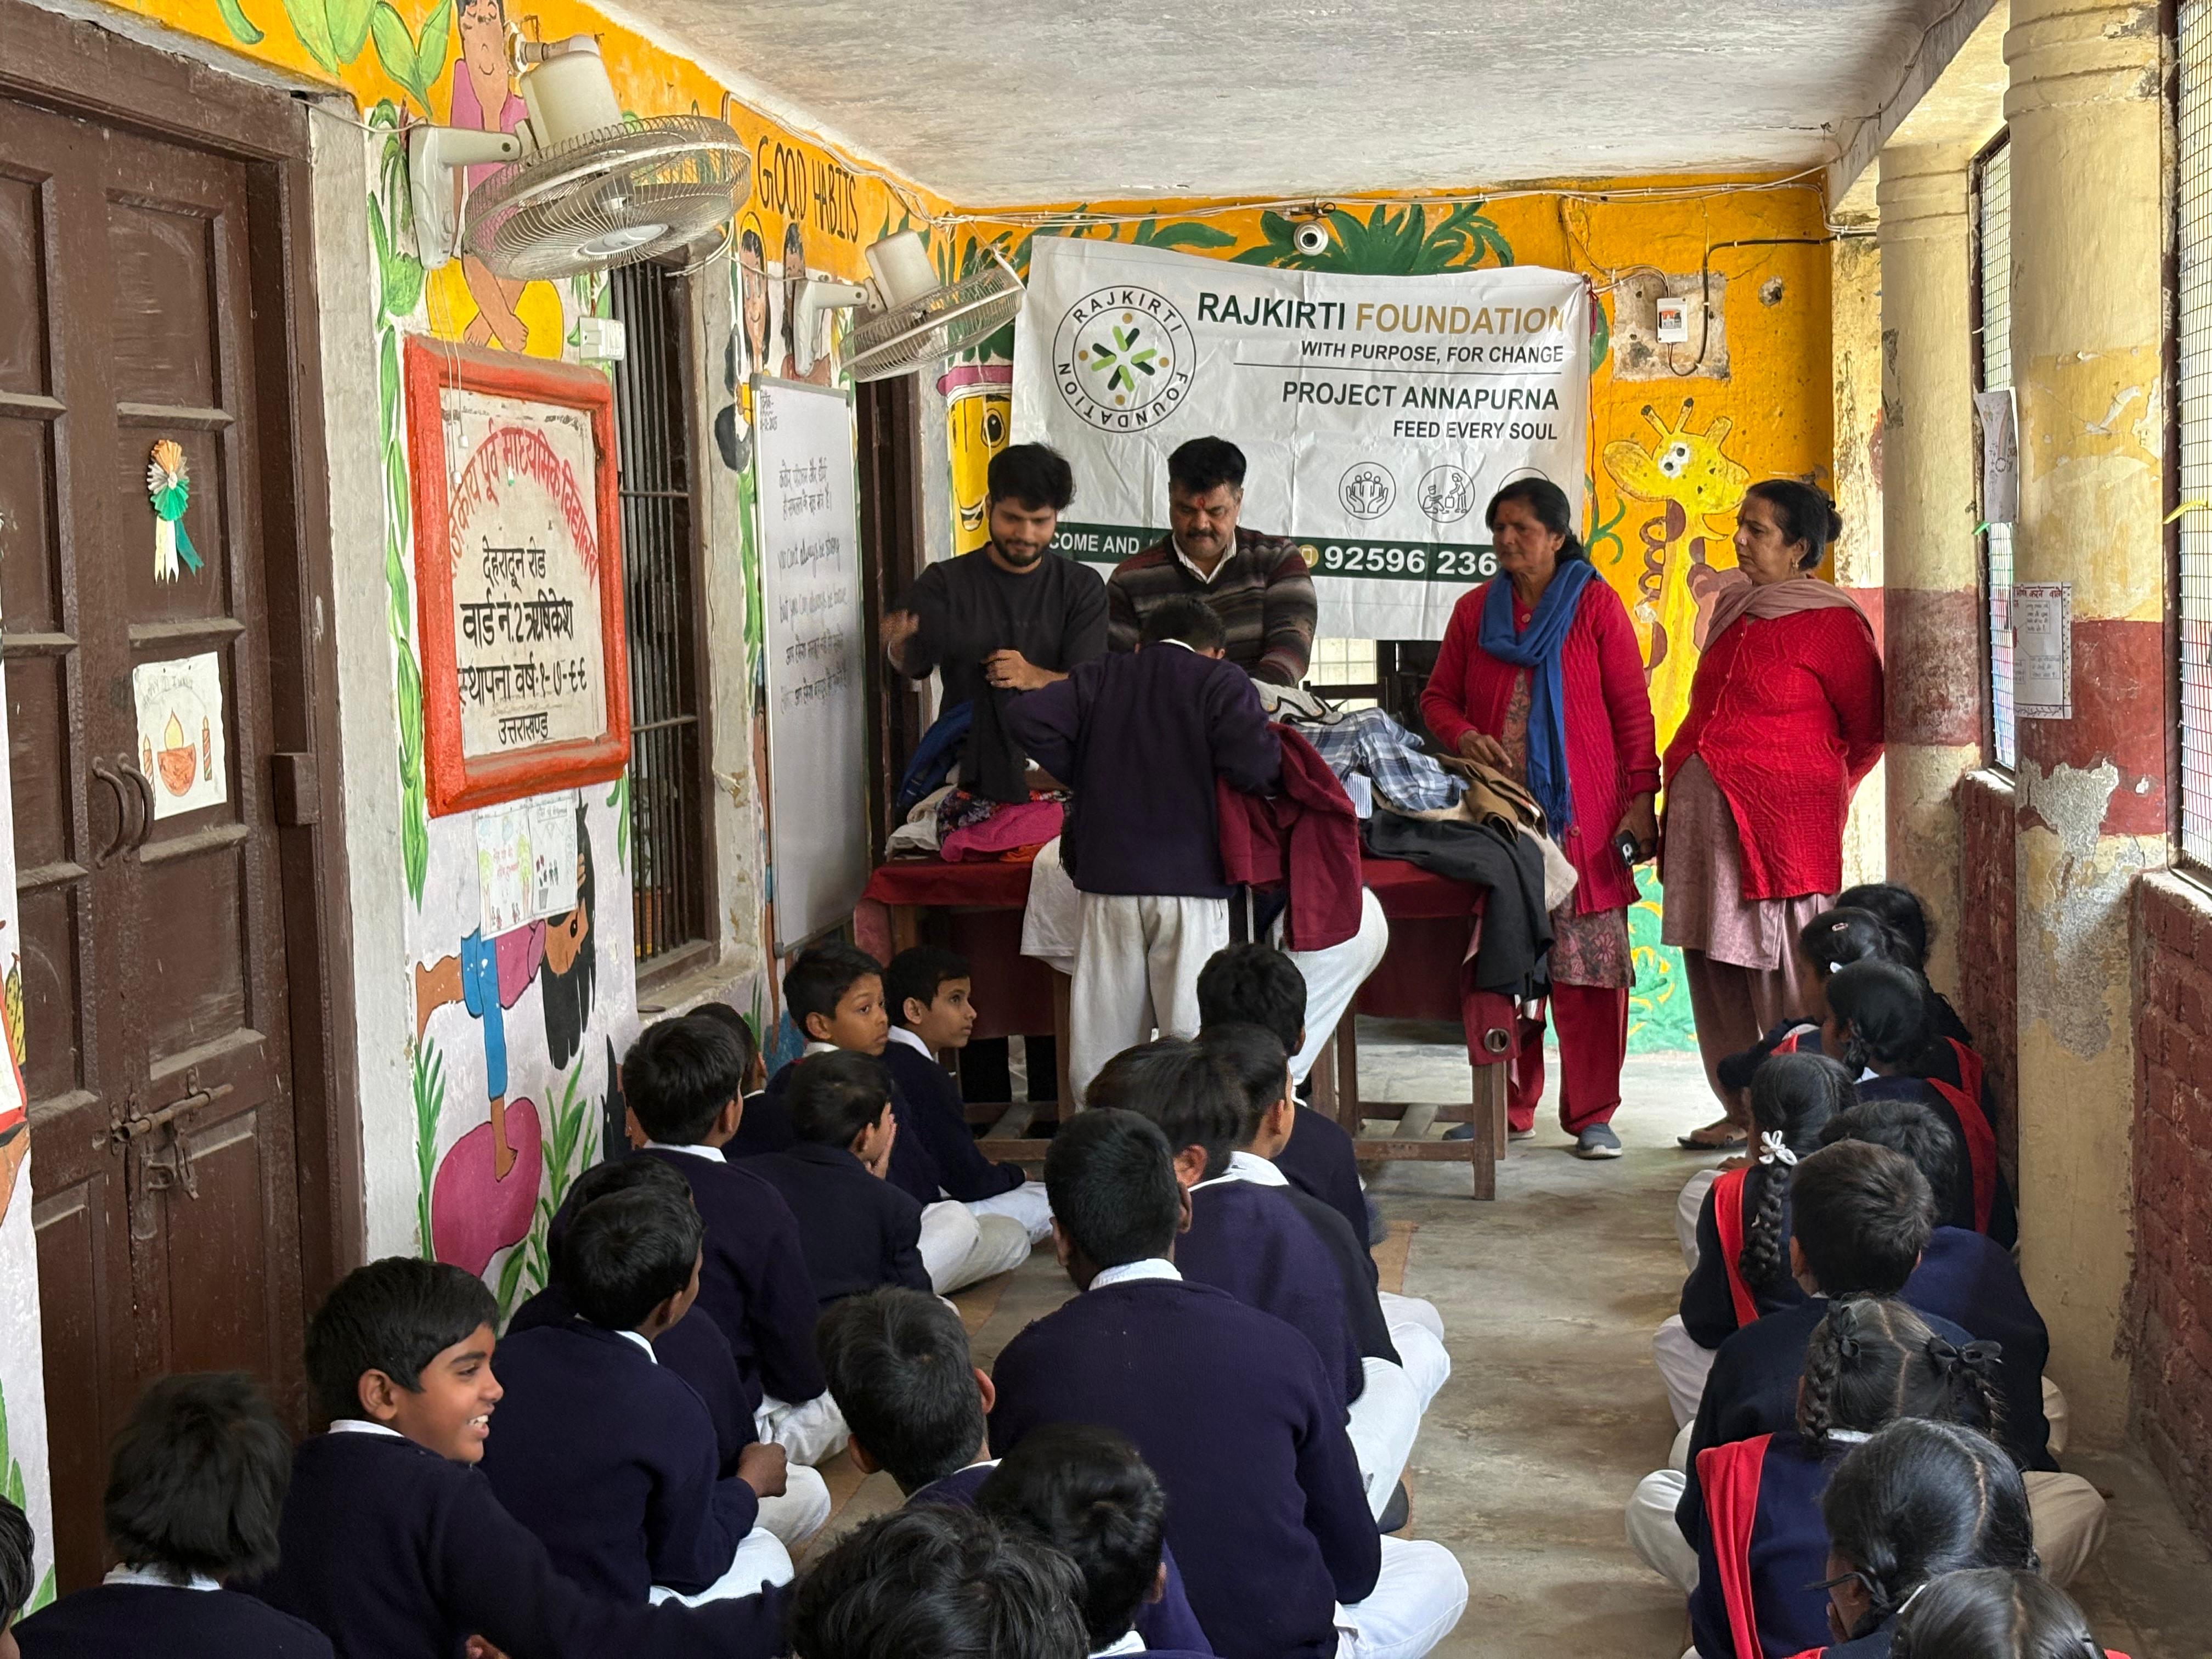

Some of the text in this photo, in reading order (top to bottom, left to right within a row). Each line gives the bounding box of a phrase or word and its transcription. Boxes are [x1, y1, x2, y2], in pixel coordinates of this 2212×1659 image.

[757, 135, 859, 244] GOOD HABITS
[1073, 291, 1182, 332] RAJKIRTI
[1198, 292, 1565, 334] RAJKIRTI FOUNDATION
[1301, 340, 1564, 365] WITH PURPOSE, FOR CHANGE
[1058, 363, 1188, 428] FOUNDATION
[1282, 381, 1560, 410] PROJECT ANNAPURNA
[1393, 420, 1558, 441] FEED EVERY SOUL
[482, 535, 546, 593] देहरादून रोड
[1102, 535, 1139, 555] AND
[1324, 546, 1426, 573] 92596
[460, 587, 494, 649] वार्ड
